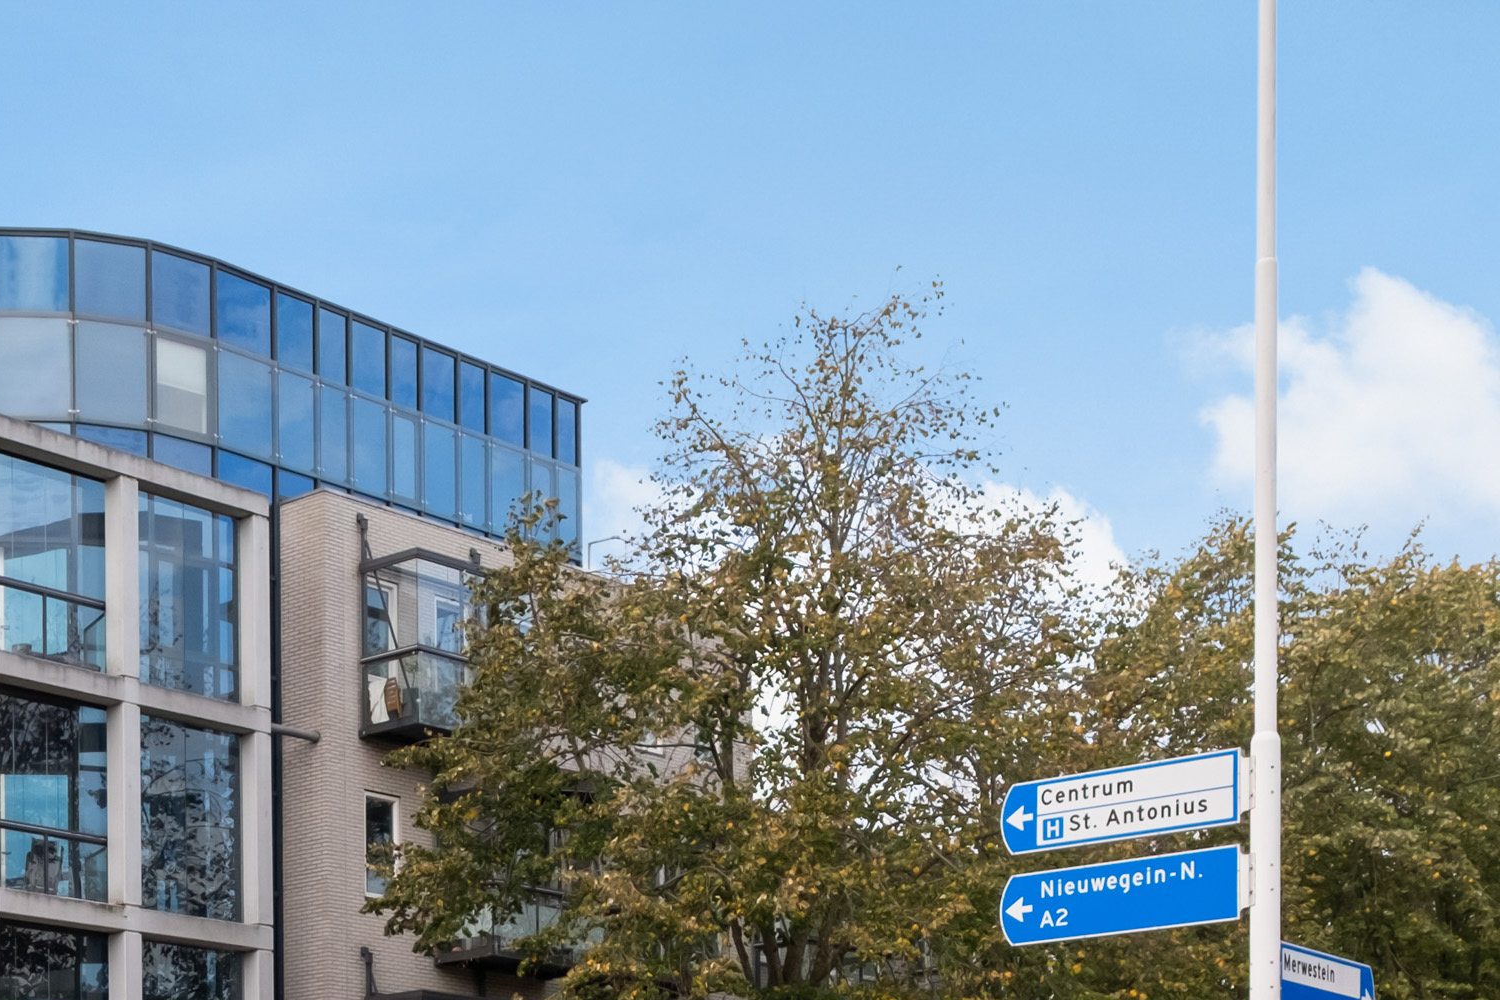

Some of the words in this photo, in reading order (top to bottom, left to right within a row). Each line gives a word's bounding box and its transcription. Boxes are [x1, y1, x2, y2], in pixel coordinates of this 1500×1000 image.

[1041, 780, 1133, 805] Centrum
[1046, 819, 1060, 839] H
[1069, 813, 1097, 831] St.
[1106, 799, 1208, 827] Antonius
[1040, 860, 1203, 898] Nieuwegein-N.
[1039, 908, 1069, 928] A2
[1284, 952, 1336, 984] Merwestein
